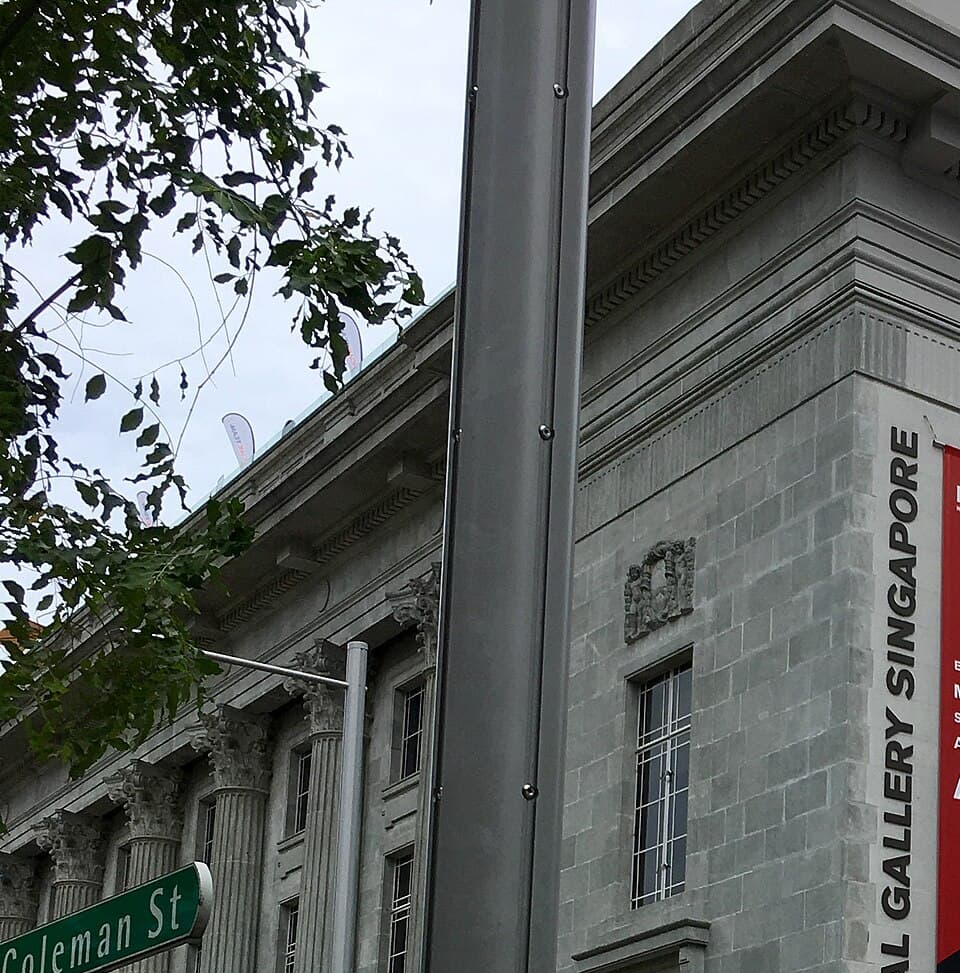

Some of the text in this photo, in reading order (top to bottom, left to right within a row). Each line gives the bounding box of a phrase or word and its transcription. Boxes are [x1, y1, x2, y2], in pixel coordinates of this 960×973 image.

[885, 425, 919, 701] SINGAPORE
[147, 884, 182, 939] St
[881, 706, 914, 921] GALLERY
